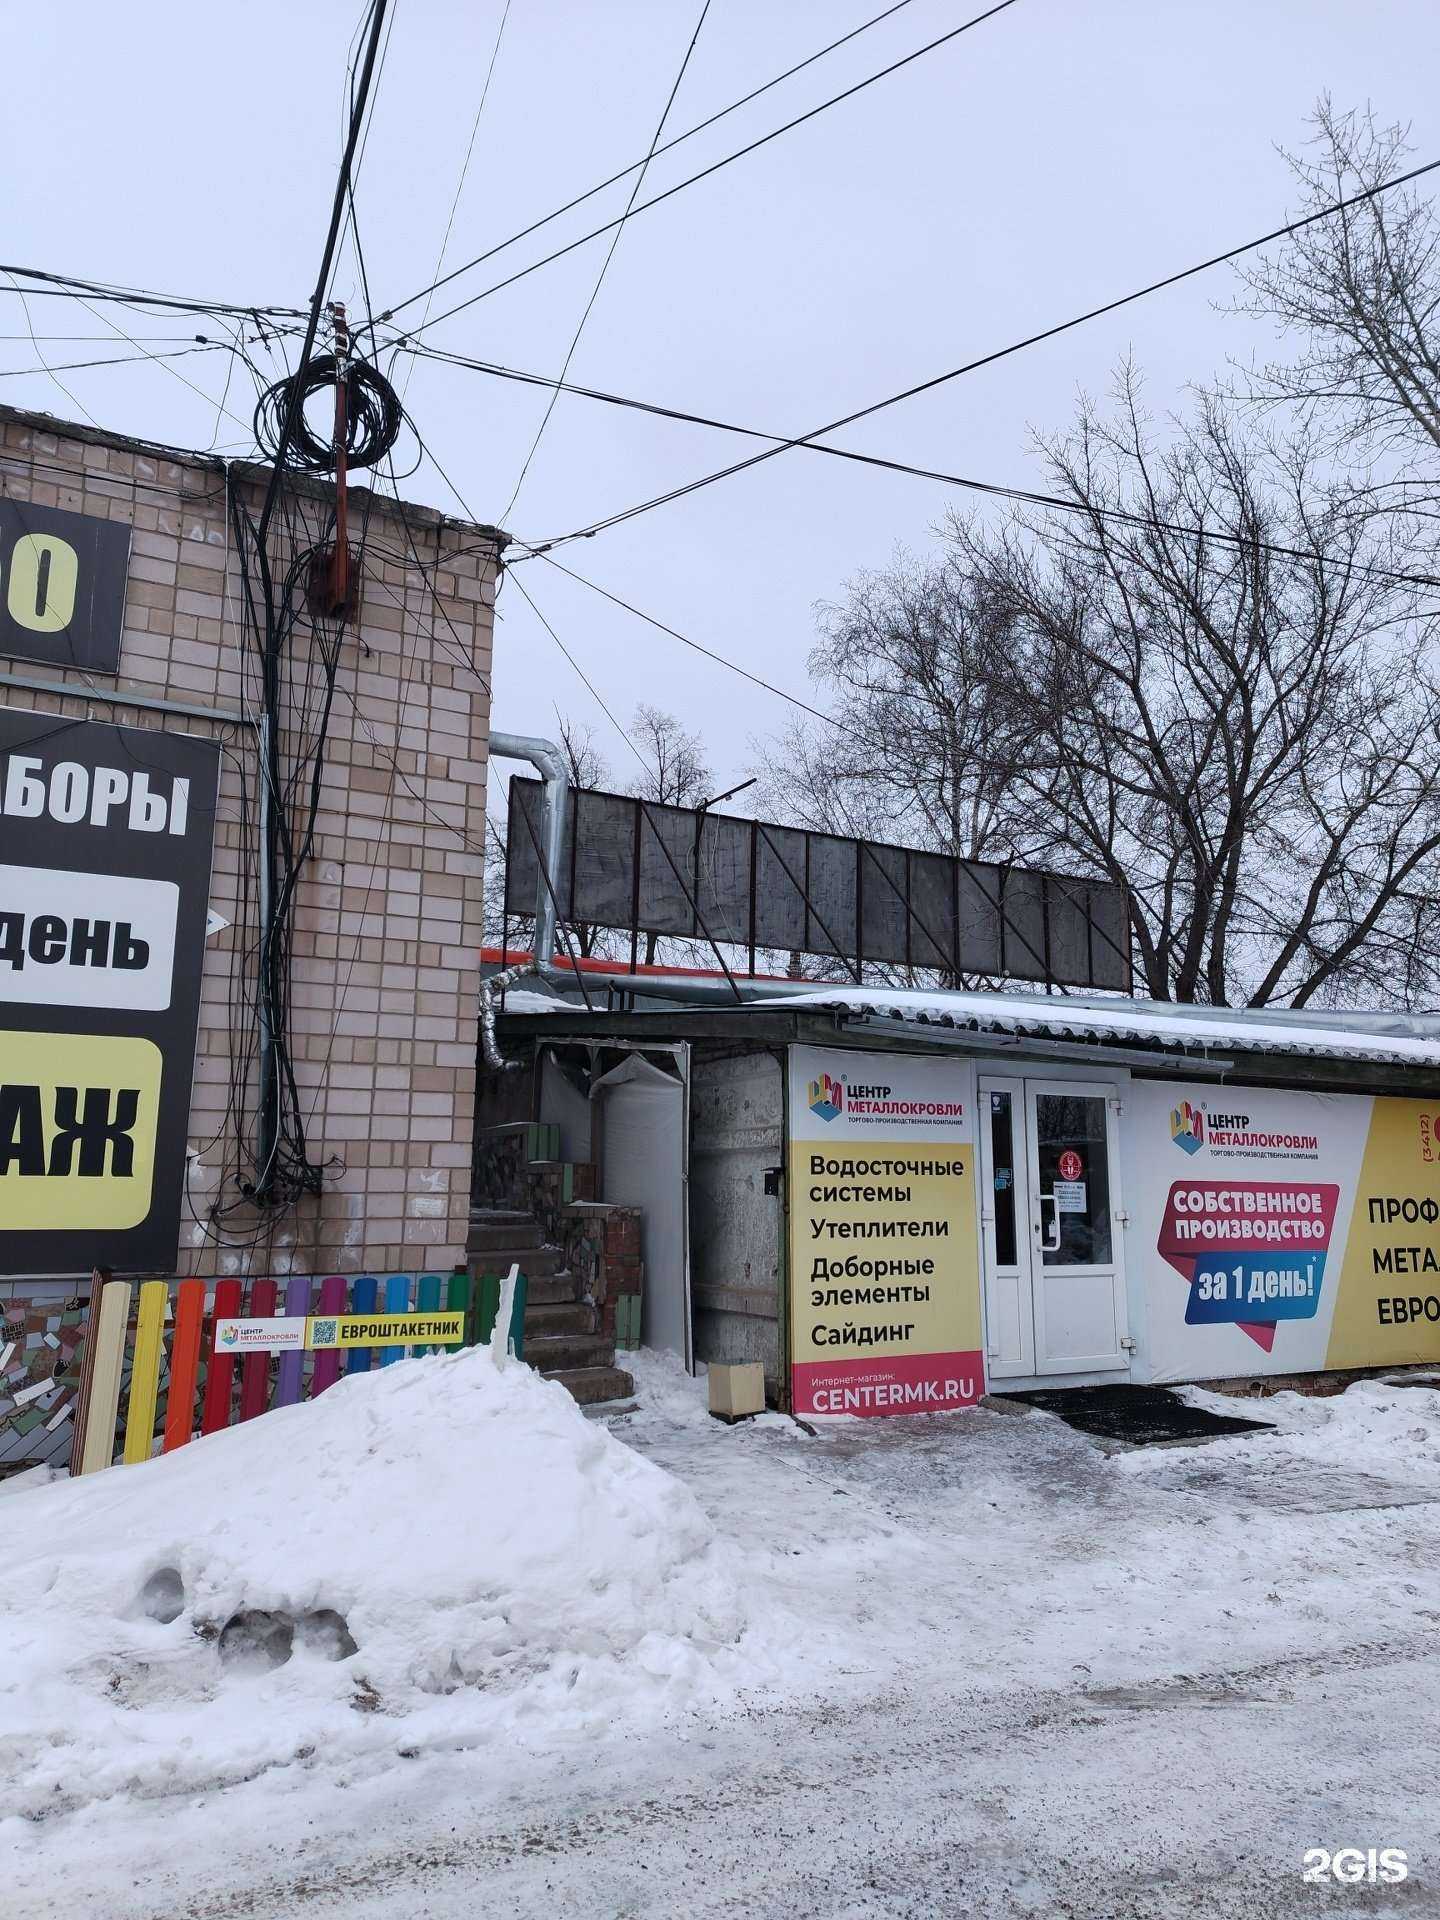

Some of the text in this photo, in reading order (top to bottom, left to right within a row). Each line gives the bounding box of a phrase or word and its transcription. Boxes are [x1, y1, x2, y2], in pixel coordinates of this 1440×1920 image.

[0, 527, 79, 633] О
[0, 755, 190, 836] БОРЫ
[847, 1084, 891, 1099] ЦЕНТР
[847, 1100, 963, 1116] МЕТАЛЛОКРОВЛИ
[1207, 1114, 1250, 1130] ЦЕНТР
[1208, 1131, 1318, 1149] МЕТАЛЛОКРОВЛИ
[810, 1155, 964, 1179] Водосточные
[809, 1185, 911, 1202] системы
[1173, 1190, 1323, 1214] СОБСТВЕННОЕ
[1368, 1198, 1440, 1224] ПРОФ
[810, 1219, 949, 1240] Утеплители
[1175, 1219, 1326, 1242] ПРОИЗВОДСТВО
[810, 1256, 935, 1283] Доборные
[1373, 1247, 1440, 1274] МЕТА
[810, 1284, 930, 1307] элементы
[1198, 1272, 1227, 1301] за
[1231, 1266, 1243, 1299] 1
[1377, 1296, 1440, 1325] ЕВРО
[341, 1321, 460, 1339] ЕВРОШТАКЕТНИК
[811, 1323, 915, 1347] Сайдинг
[811, 1374, 896, 1386] Интернет-магазин:
[812, 1378, 974, 1412] CENTERMK.RU
